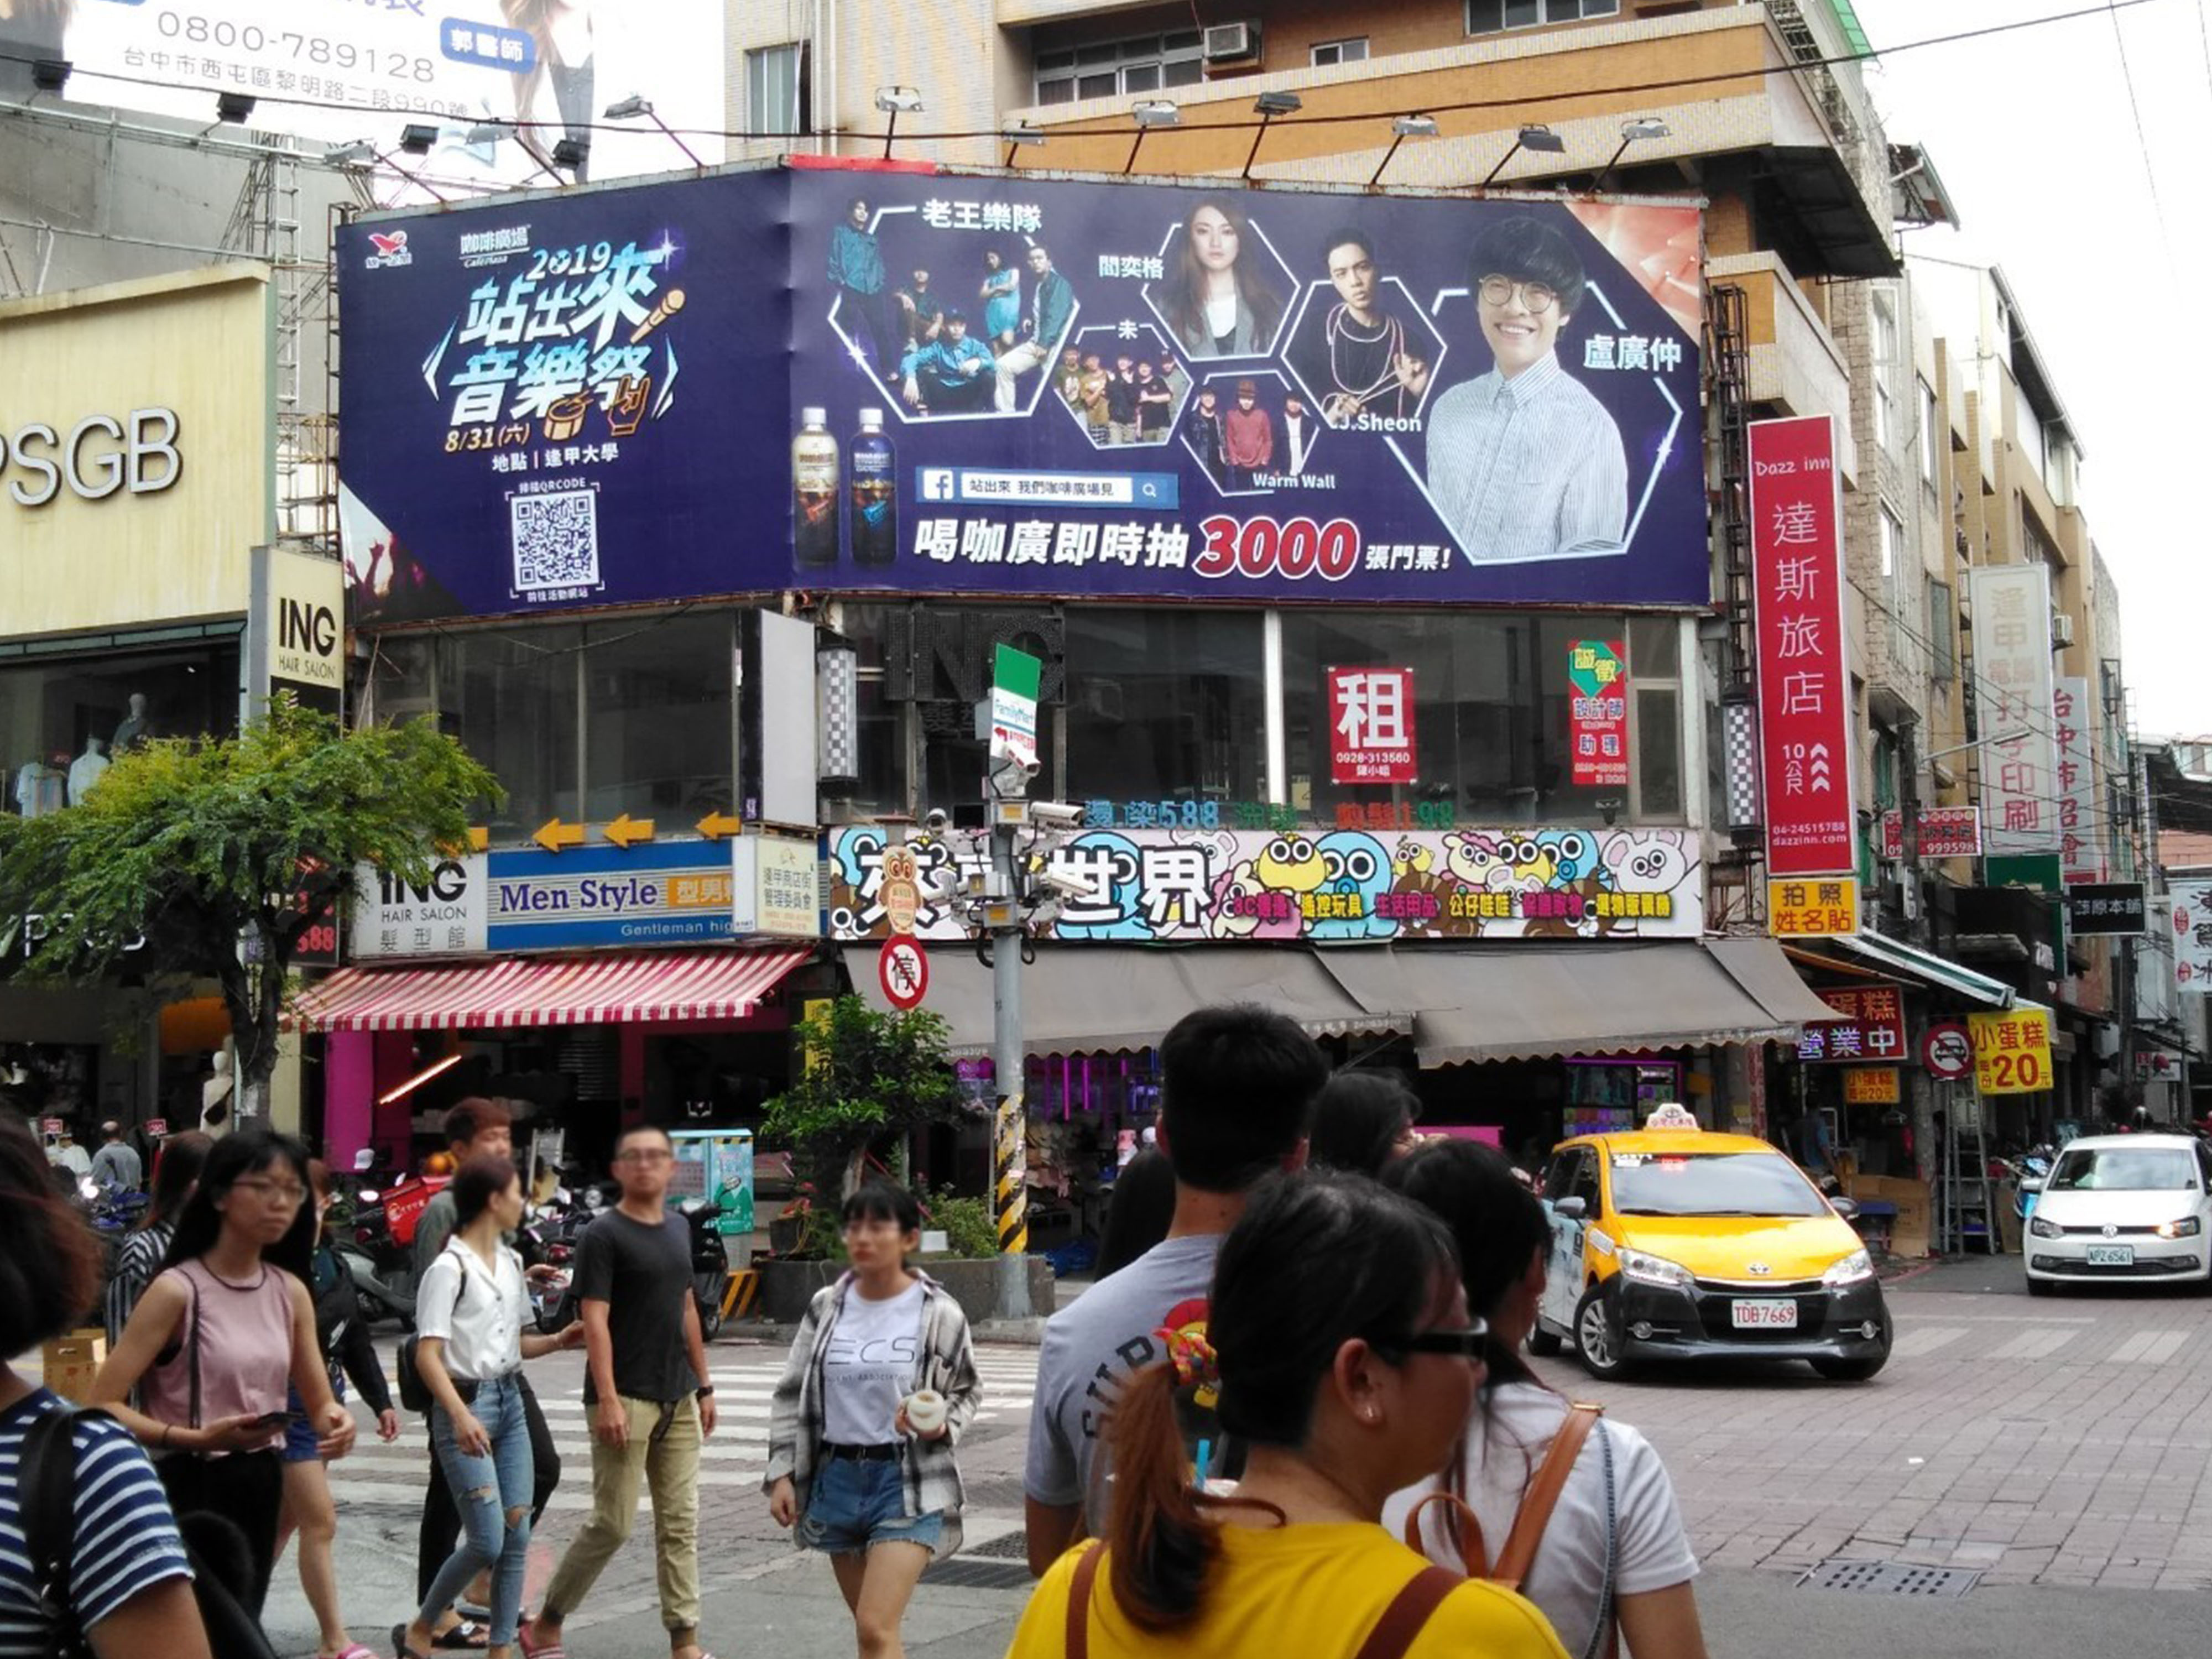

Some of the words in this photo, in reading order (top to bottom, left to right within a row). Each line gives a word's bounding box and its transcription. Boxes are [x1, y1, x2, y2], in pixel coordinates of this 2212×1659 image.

[157, 10, 435, 84] 0800-789128
[922, 199, 1042, 233] 老王樂隊
[525, 241, 611, 281] 2019
[458, 241, 665, 352] 站出來
[1118, 319, 1139, 341] 未
[1583, 335, 1682, 373] 盧廣仲
[448, 337, 653, 427] 音樂祭
[0, 407, 182, 507] SGB
[1755, 460, 1796, 477] Dazz
[1804, 455, 1830, 471] inn
[969, 479, 1011, 496] 站出來
[1016, 479, 1115, 498] 我們咖啡廣場見
[1253, 471, 1299, 490] Warm
[1301, 472, 1336, 490] Wall
[914, 517, 1190, 570] 喝咖廣即時抽
[1192, 514, 1360, 581] 3000
[1772, 499, 1824, 716] 達斯旅店
[279, 597, 336, 658] ING
[278, 654, 299, 673] HAIR
[304, 661, 336, 680] SALON
[1335, 673, 1408, 749] 租
[1782, 744, 1804, 758] 10
[1785, 760, 1803, 796] 公尺
[2053, 688, 2088, 867] 台中市召會
[382, 860, 467, 905] ING
[499, 883, 570, 912] Men
[580, 877, 658, 912] Style
[1782, 883, 1843, 907] 拍照
[382, 909, 413, 923] HAIR
[420, 906, 467, 921] SALON
[621, 923, 703, 937] Gentleman
[1774, 909, 1851, 932] 姓名貼
[891, 954, 916, 990] 停
[1974, 1020, 2046, 1051] 小蛋糕
